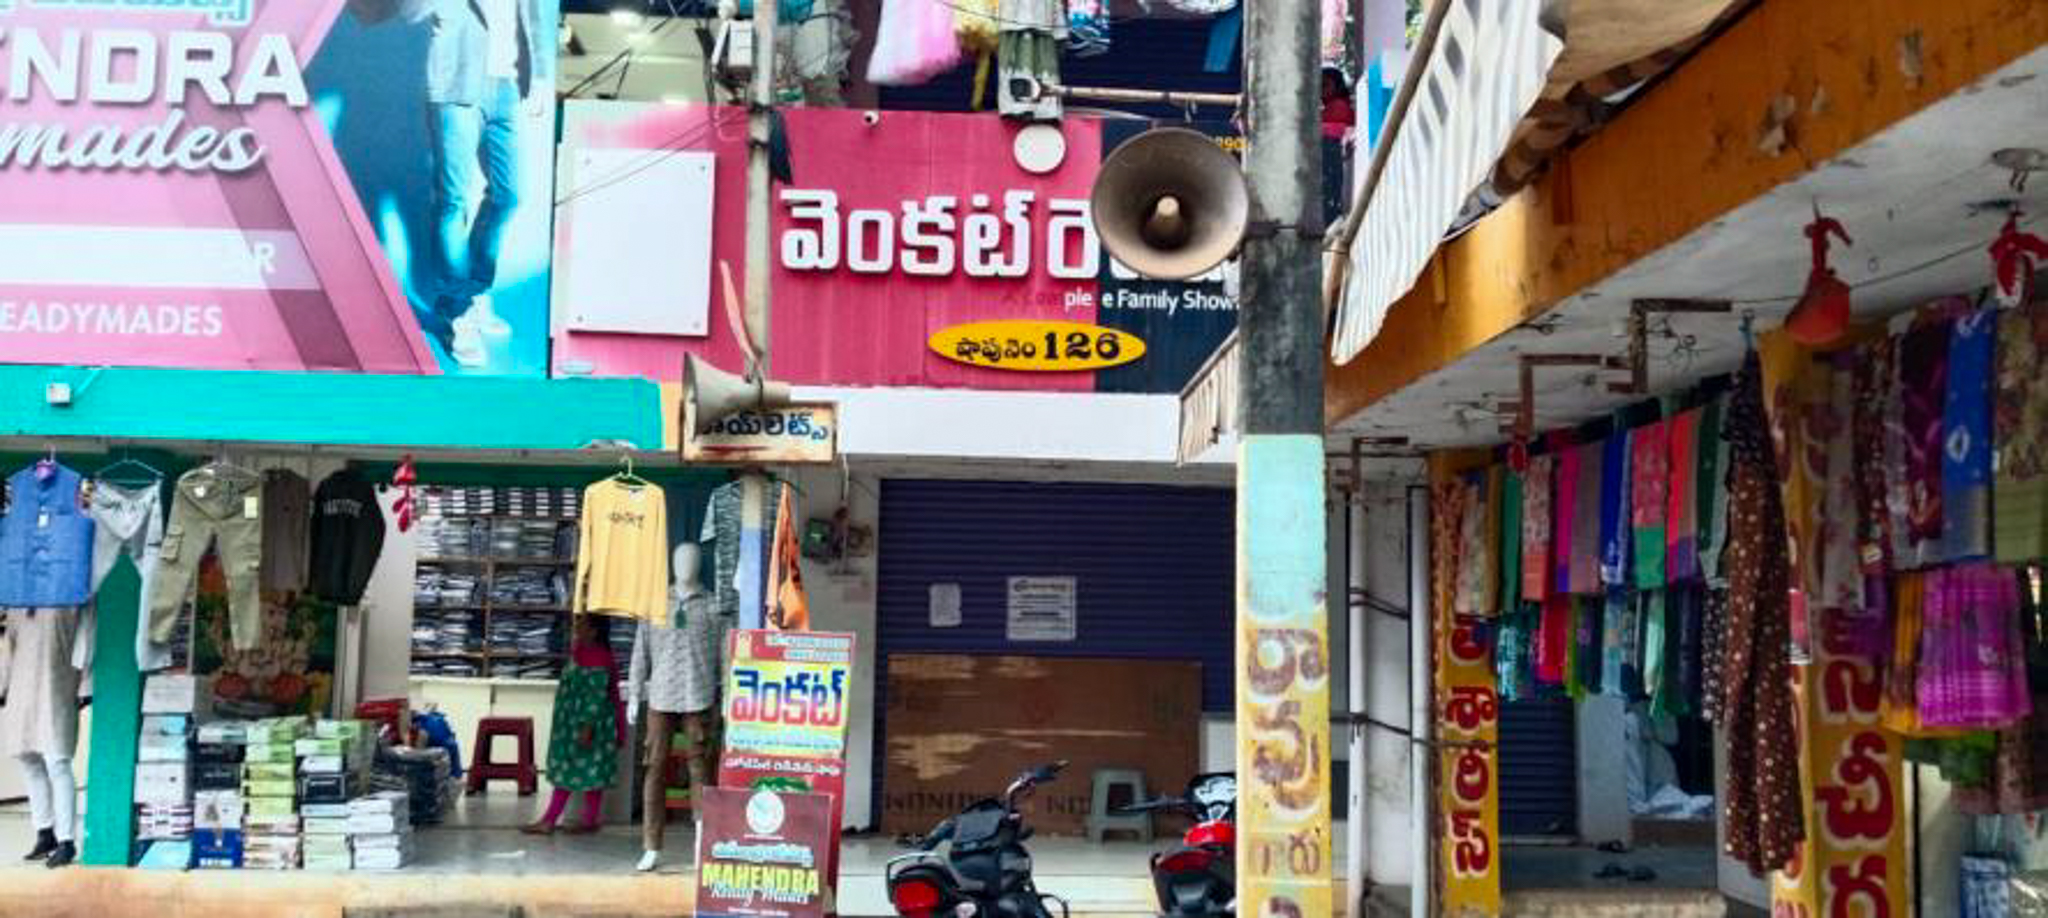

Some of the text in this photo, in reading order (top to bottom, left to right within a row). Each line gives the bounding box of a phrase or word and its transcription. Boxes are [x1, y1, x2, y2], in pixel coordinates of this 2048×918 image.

[0, 28, 310, 107] NDRA
[779, 188, 1035, 278] వెంకట్
[1118, 289, 1178, 315] Family
[1183, 290, 1239, 311] Show
[1044, 331, 1121, 360] 126
[731, 669, 846, 728] వెంకట్
[702, 863, 820, 896] MAHENDRA
